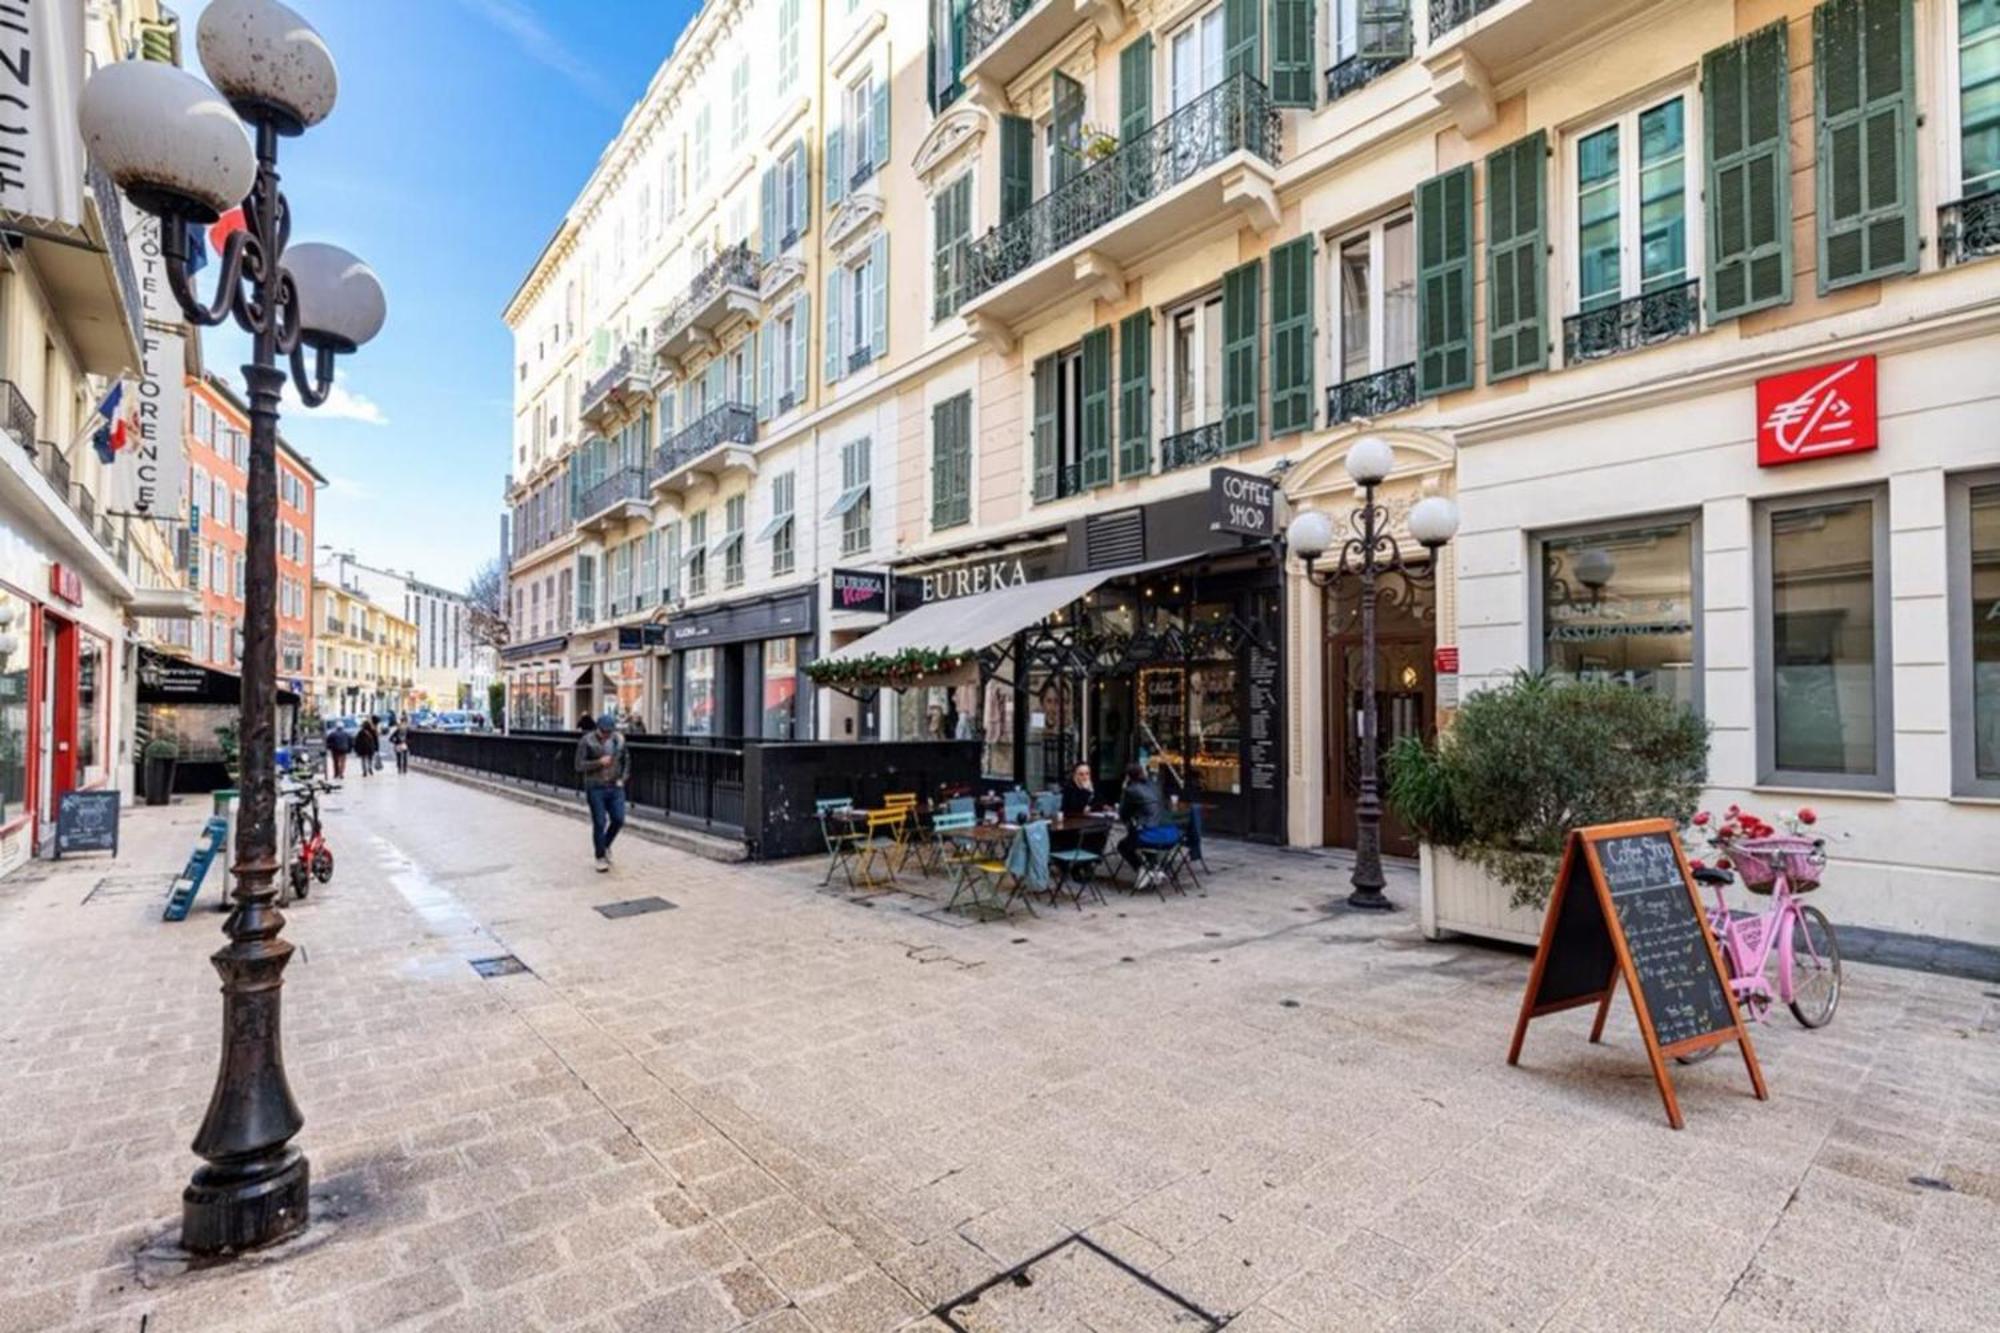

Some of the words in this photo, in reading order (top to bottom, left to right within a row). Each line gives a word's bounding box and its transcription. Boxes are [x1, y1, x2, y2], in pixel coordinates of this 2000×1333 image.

[137, 338, 162, 506] FLORENCE
[1223, 476, 1270, 506] COFFEE
[1229, 503, 1264, 530] SHOP
[921, 558, 1027, 602] EUREKA
